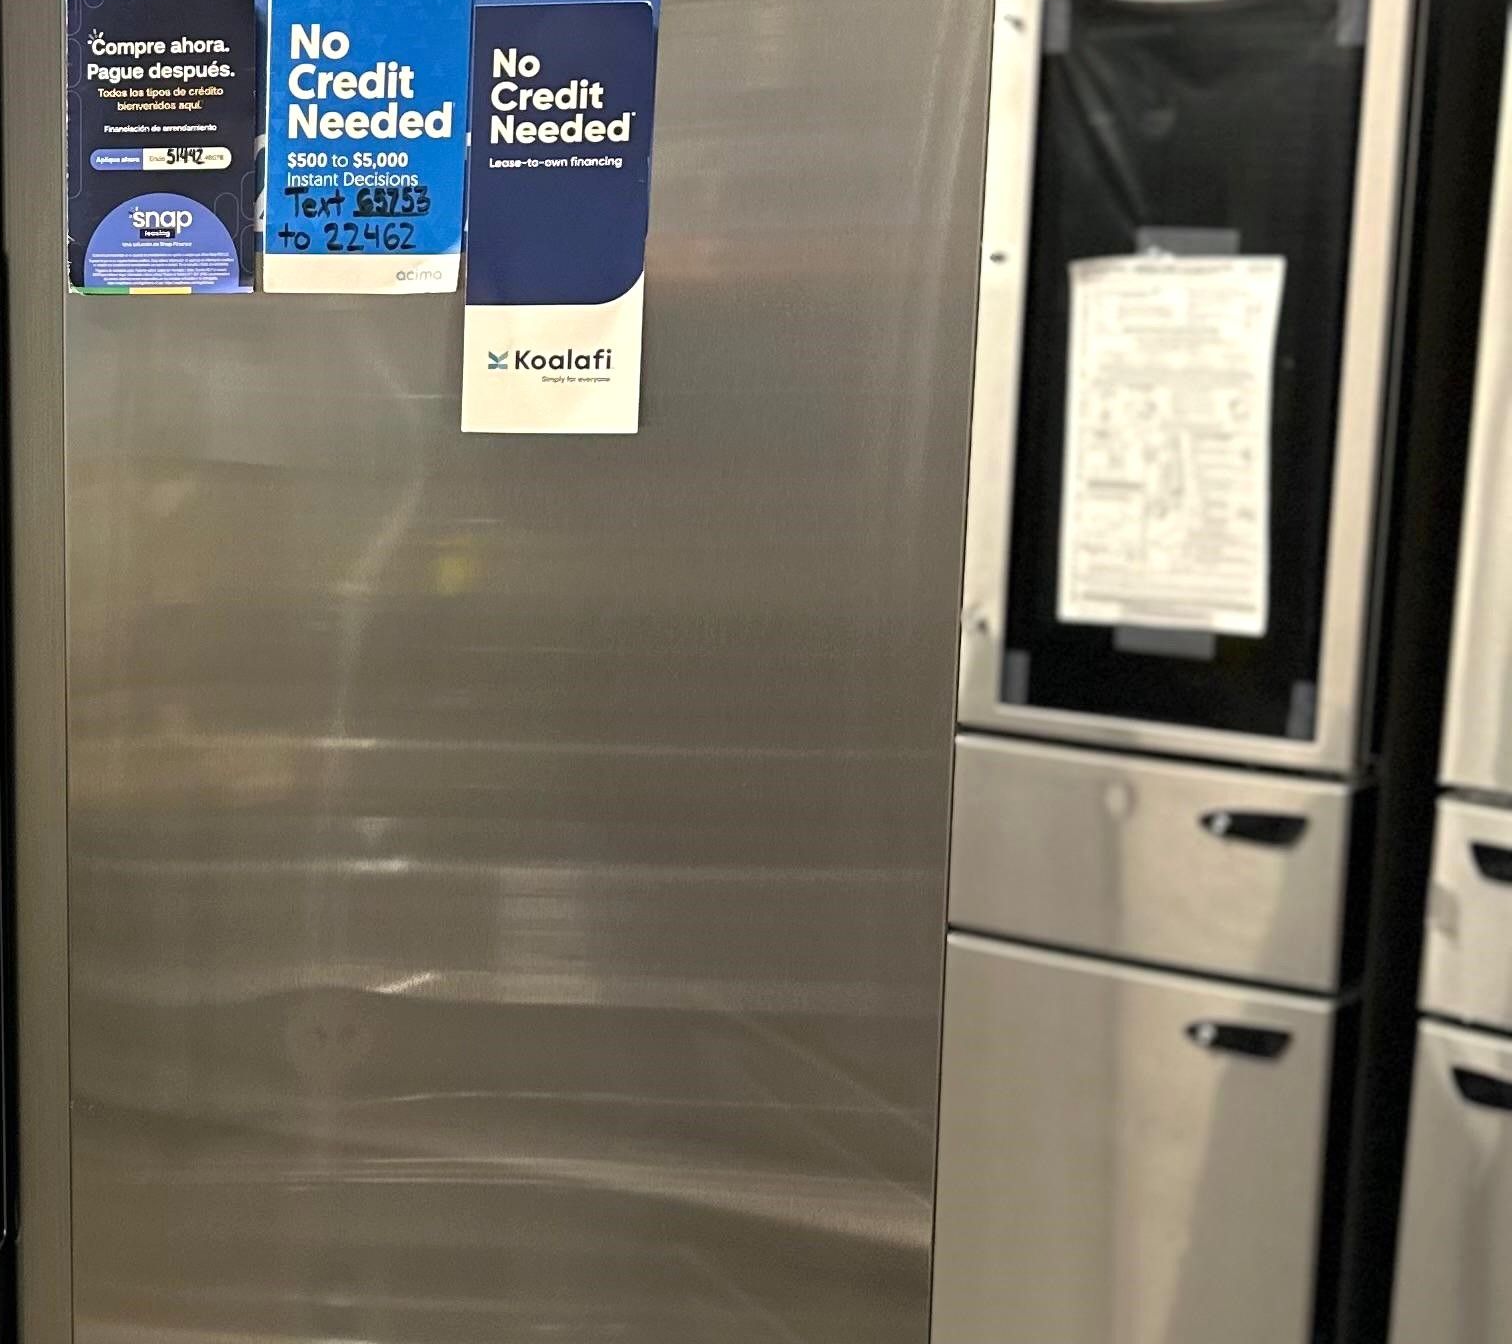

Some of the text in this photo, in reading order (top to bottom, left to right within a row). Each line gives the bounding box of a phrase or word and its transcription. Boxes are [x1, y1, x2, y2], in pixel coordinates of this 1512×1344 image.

[91, 36, 230, 58] Compre ahora.
[290, 23, 350, 60] No
[87, 60, 235, 83] Pague después.
[492, 47, 541, 78] No
[97, 85, 224, 99] Todos los tipos de crédito
[288, 61, 415, 100] Credit
[117, 100, 177, 111] bienvenidos
[490, 78, 604, 112] Credit
[287, 101, 453, 139] Needed
[287, 151, 409, 170] $500 to $5,000
[489, 156, 623, 169] Lease-to-own financing
[287, 171, 419, 187] Instant Decisions
[284, 186, 346, 218] Text
[133, 210, 193, 234] snap
[278, 222, 417, 252] to 22462
[396, 269, 443, 281] acima
[514, 348, 612, 370] Koalafi
